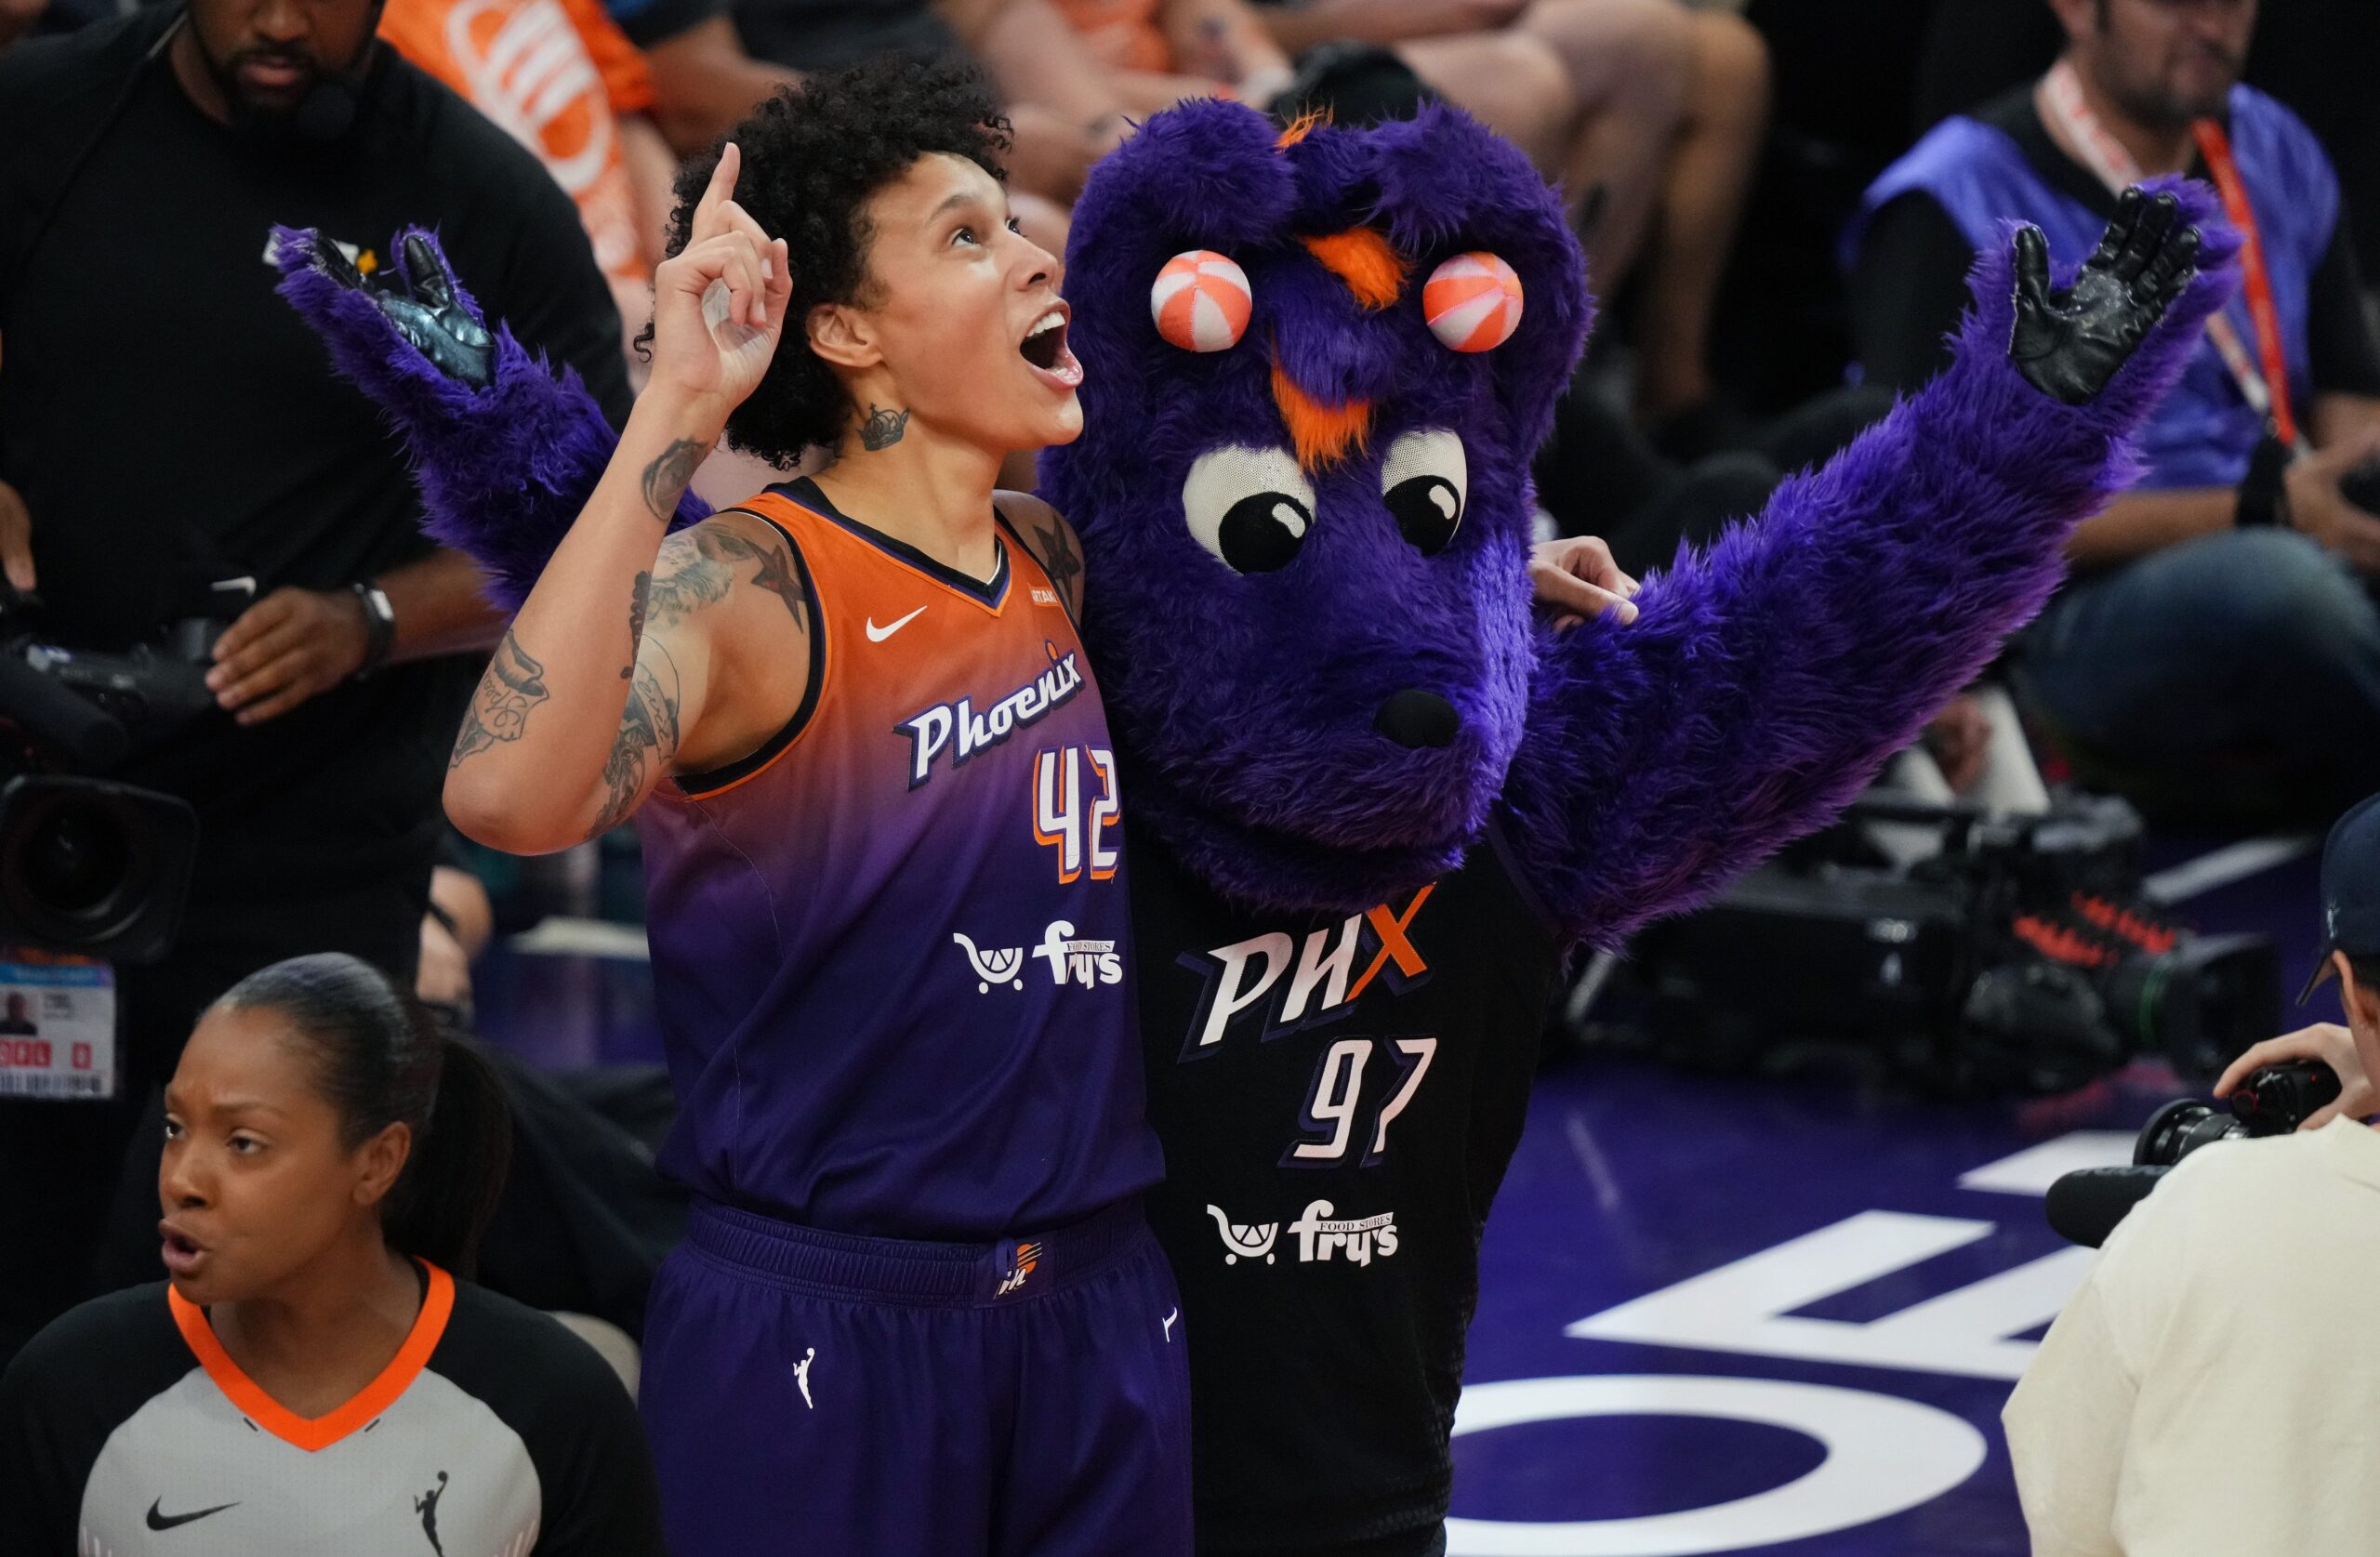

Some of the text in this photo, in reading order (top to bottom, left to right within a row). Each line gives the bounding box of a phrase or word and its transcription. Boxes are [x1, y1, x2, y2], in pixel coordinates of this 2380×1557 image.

[894, 640, 1085, 790] Phoenix
[1033, 745, 1120, 884] 42
[1190, 881, 1437, 1053] PHX
[1286, 1036, 1438, 1164] 97
[1319, 1215, 1392, 1232] FOOD STORES
